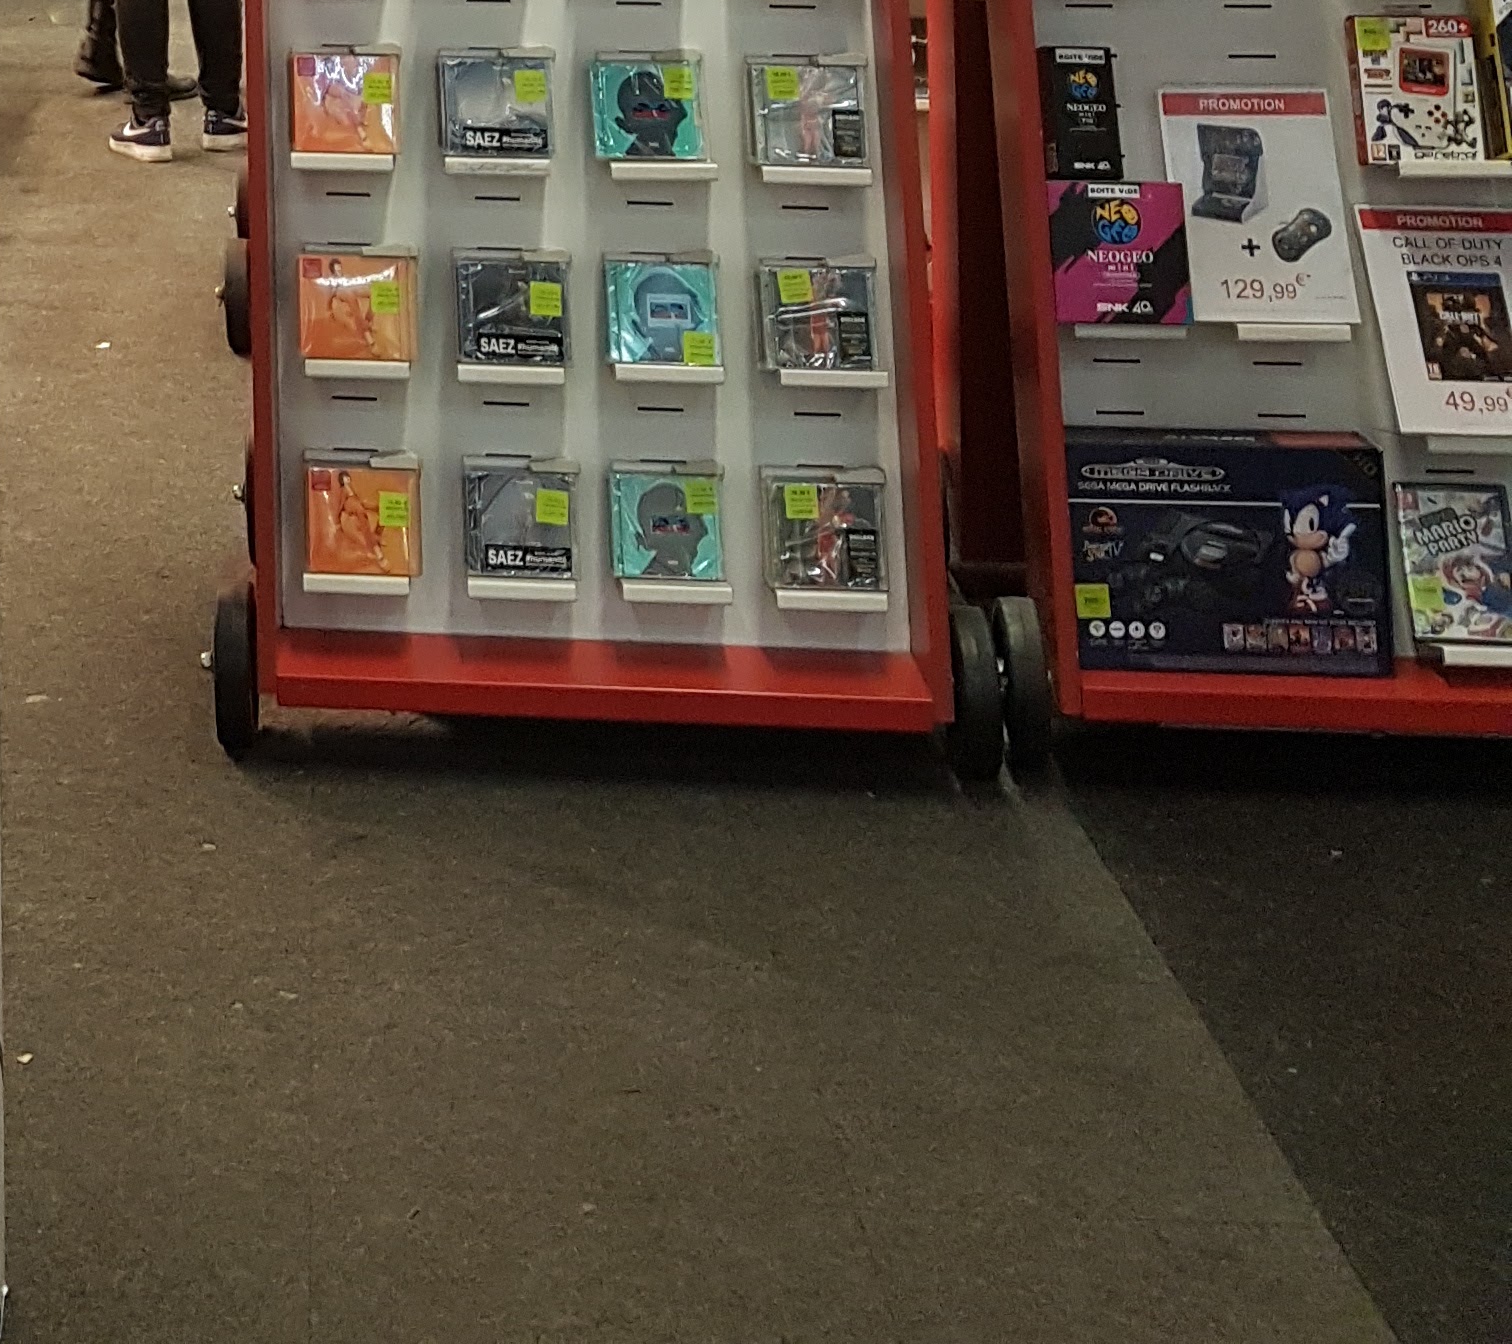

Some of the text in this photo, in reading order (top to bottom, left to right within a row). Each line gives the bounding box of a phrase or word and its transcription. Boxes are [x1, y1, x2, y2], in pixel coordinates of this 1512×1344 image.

[1427, 19, 1468, 34] 260+
[1066, 103, 1107, 112] NEOGEO
[1199, 97, 1285, 112] PROMOTION
[465, 131, 501, 147] SAEZ
[1096, 199, 1138, 225] NEO
[1397, 214, 1483, 228] PROMOTION
[1098, 219, 1138, 244] GEO
[1392, 236, 1503, 250] CALL OF DUTY
[1086, 249, 1154, 263] NEOGEO
[1401, 253, 1502, 267] BLACK OPS 4
[480, 337, 516, 354] SAEZ
[1107, 482, 1137, 490] MEGA
[1138, 482, 1169, 492] DRIVE
[1415, 515, 1477, 546] MARIO
[1428, 531, 1479, 556] PARTY
[488, 549, 524, 566] SAEZ
